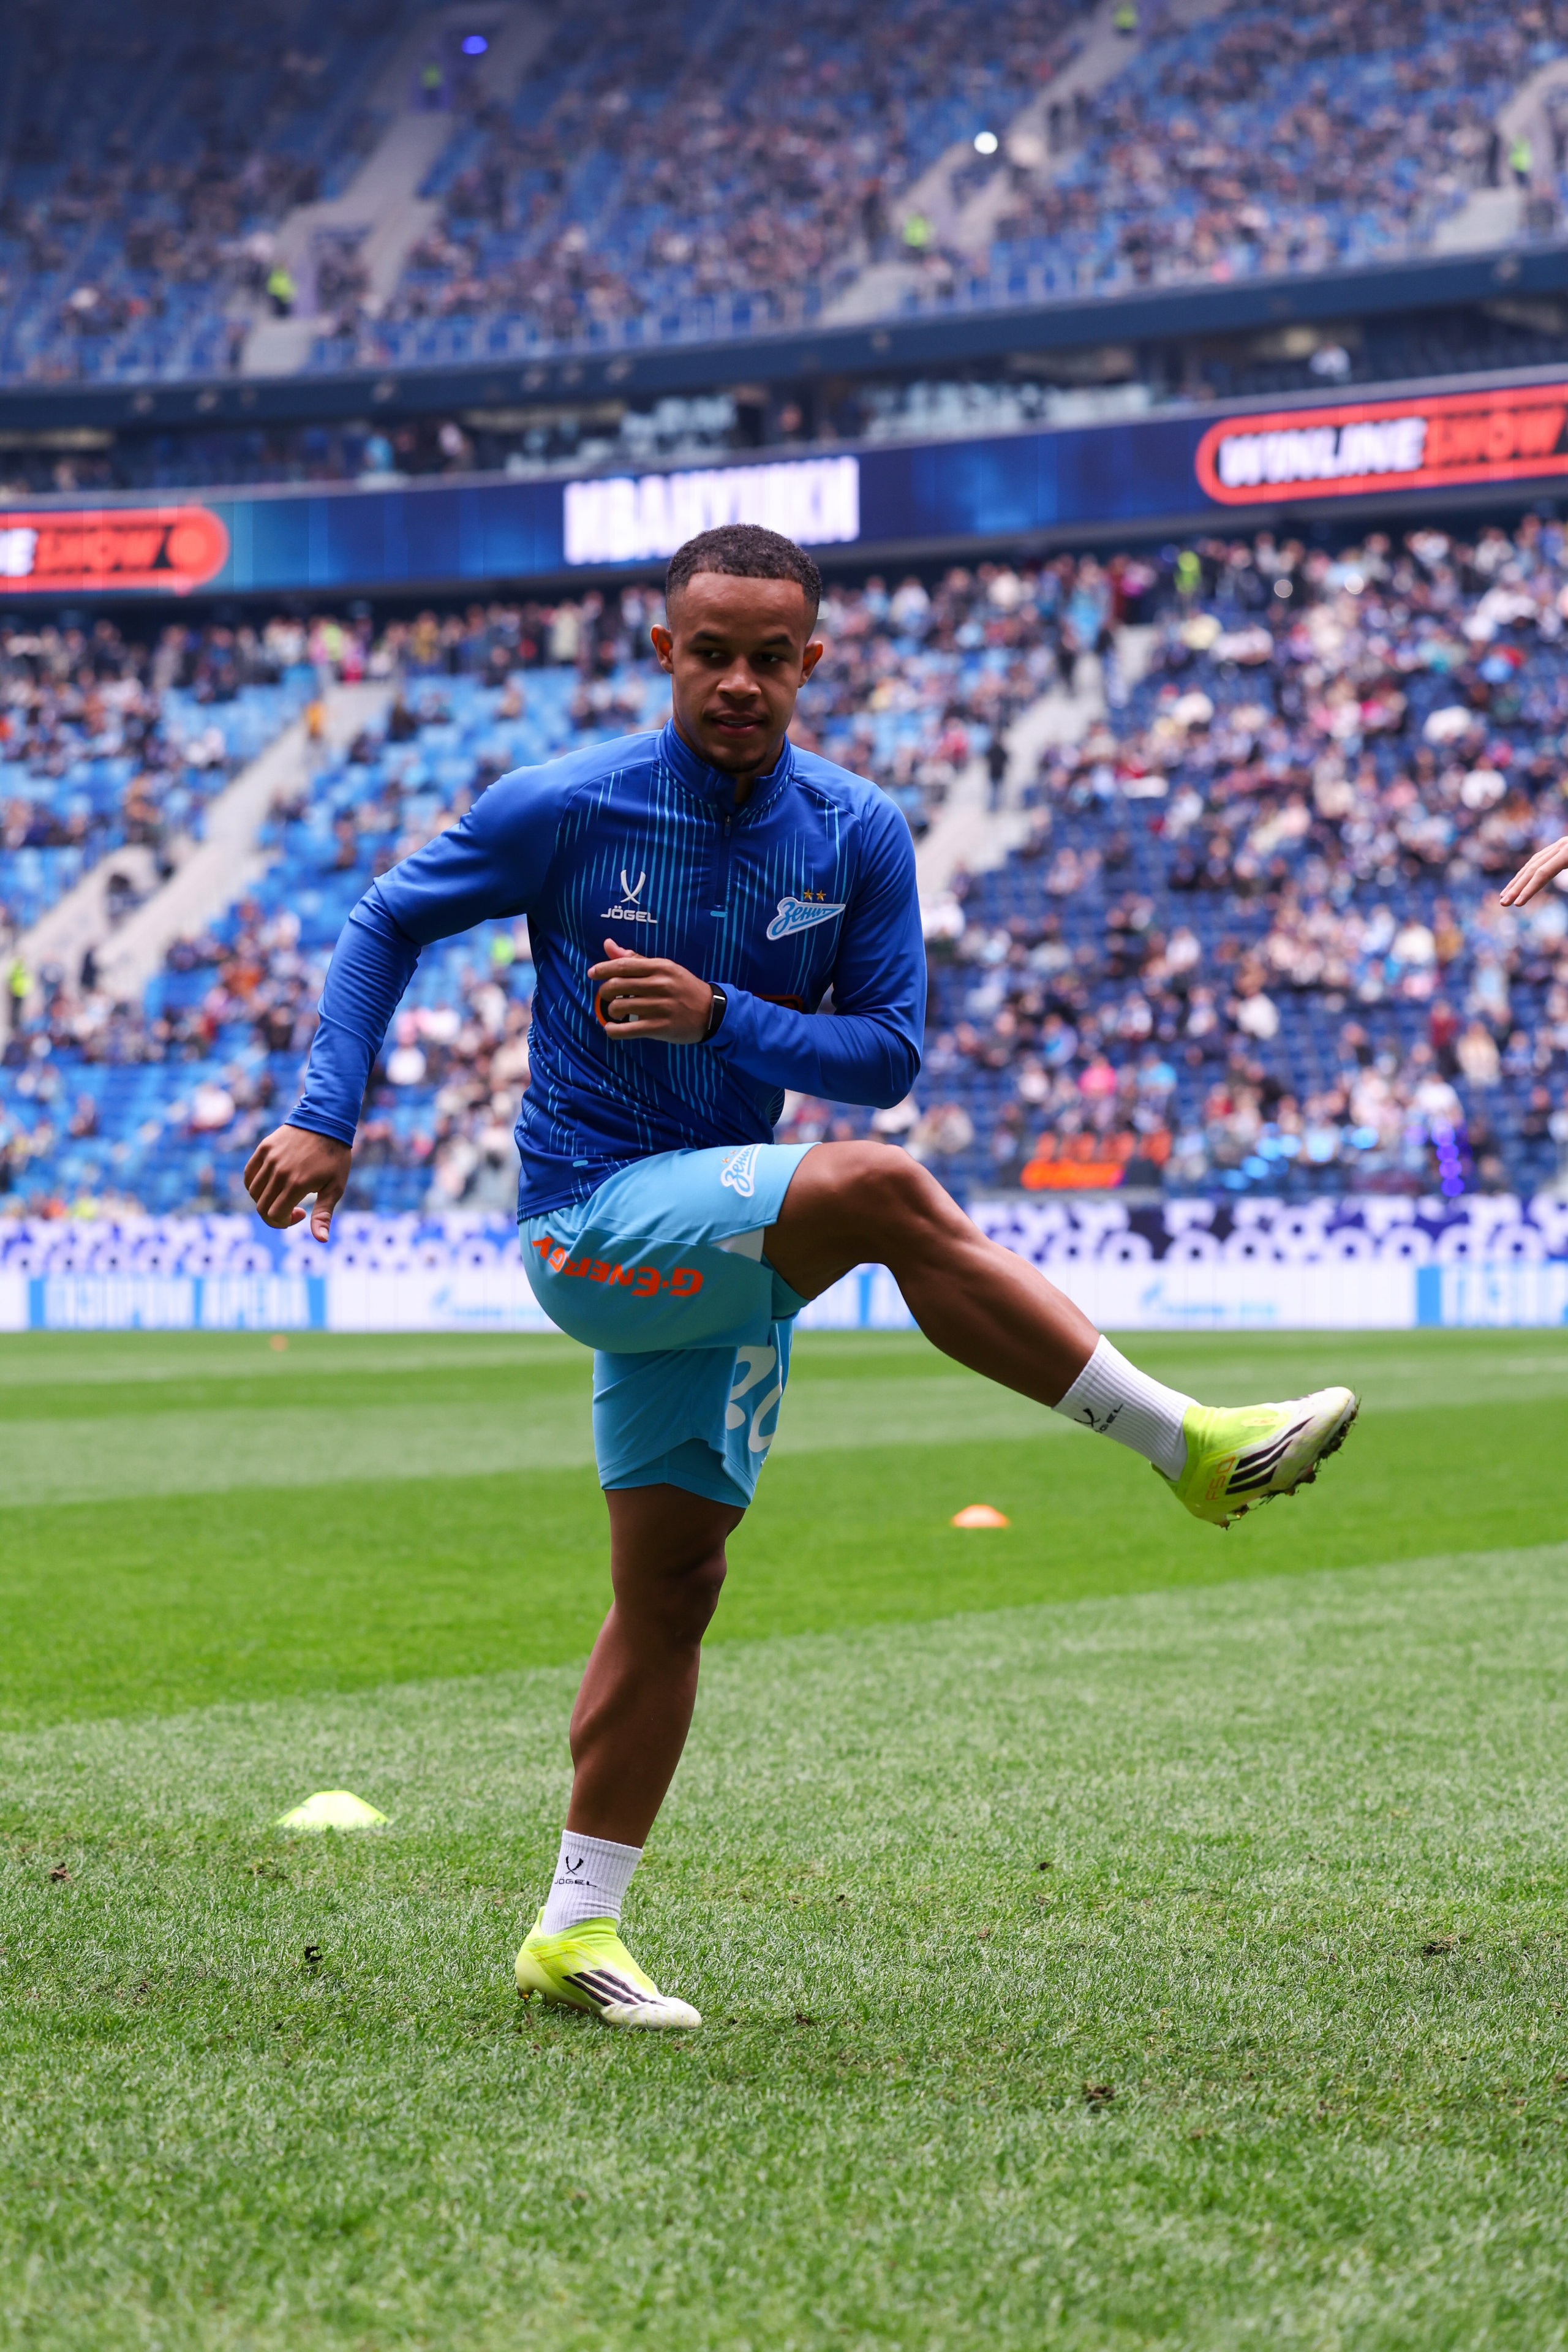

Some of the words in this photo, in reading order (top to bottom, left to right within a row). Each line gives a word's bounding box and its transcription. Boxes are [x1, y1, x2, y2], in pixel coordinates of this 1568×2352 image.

[600, 905, 658, 924] JÖGEL
[771, 901, 841, 936] Зенит
[554, 1876, 598, 1888] JÖGEL
